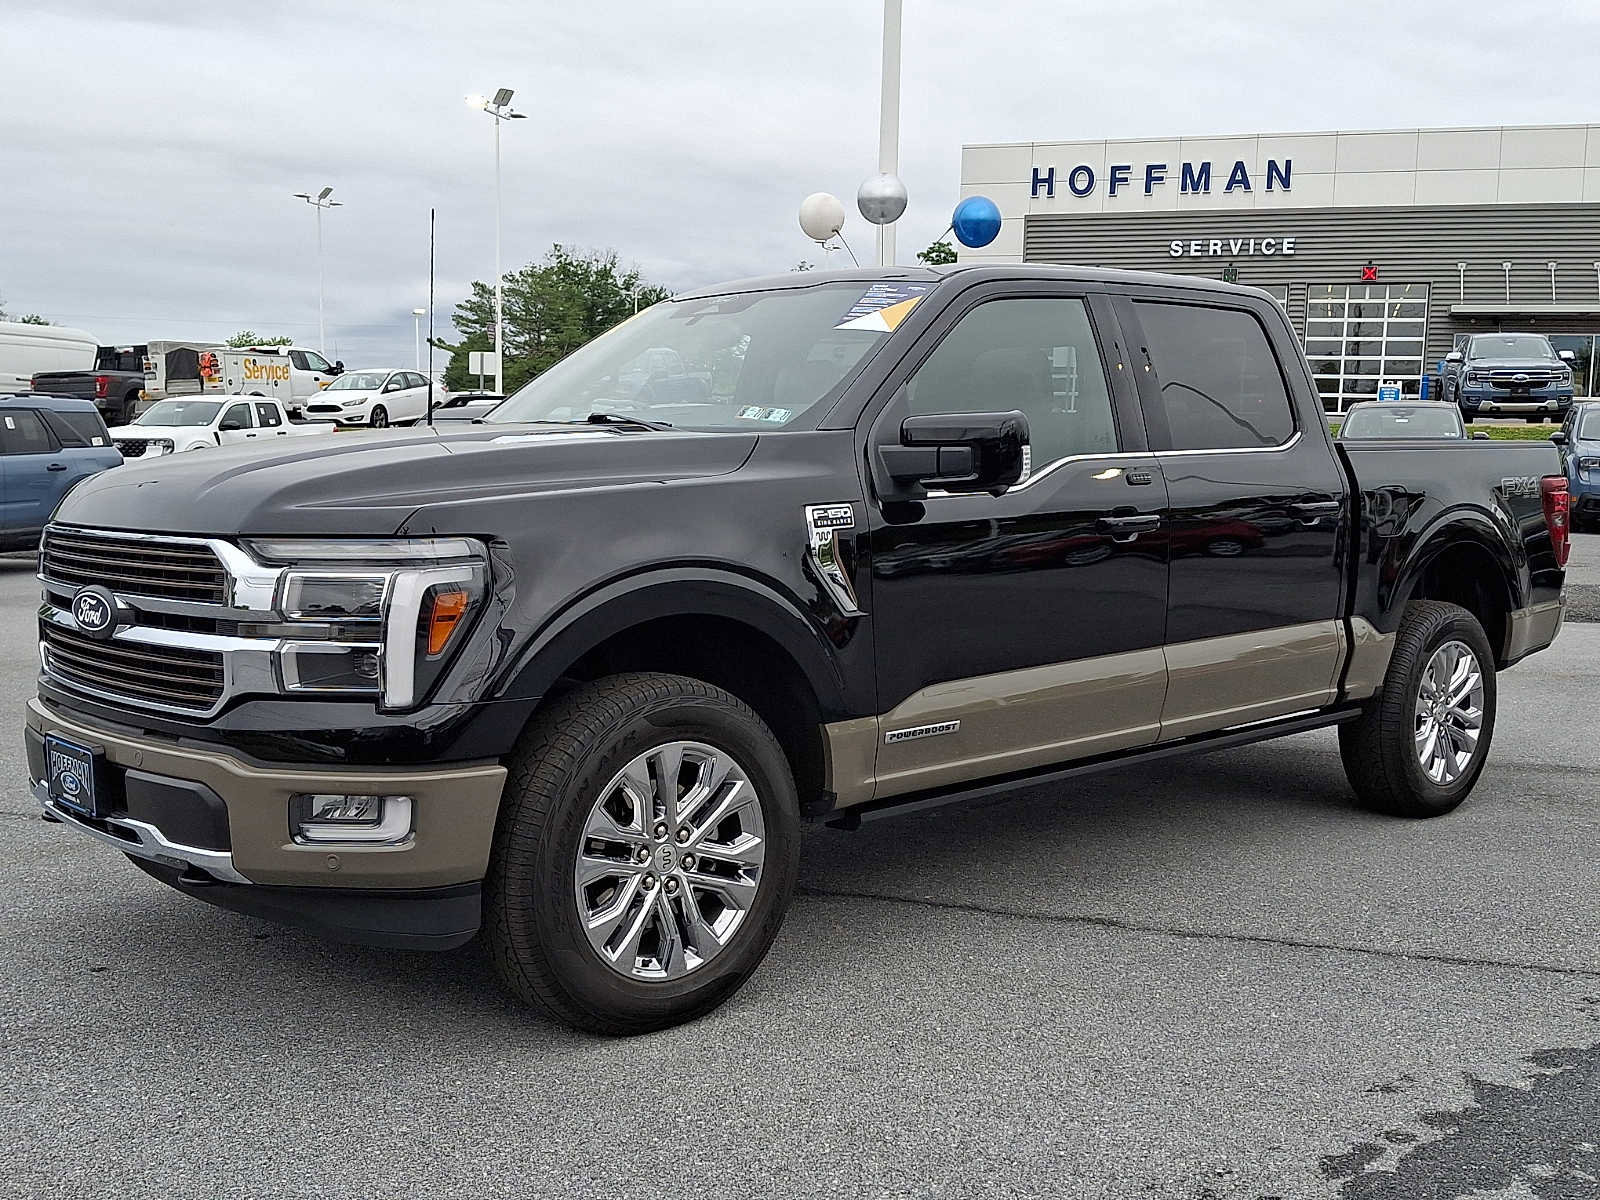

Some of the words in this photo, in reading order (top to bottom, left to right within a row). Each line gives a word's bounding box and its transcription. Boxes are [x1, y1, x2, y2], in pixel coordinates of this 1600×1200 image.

[1031, 159, 1292, 198] HOFFMAN
[1169, 238, 1296, 257] SERVICE
[243, 358, 289, 380] Service
[1501, 477, 1538, 498] FX4
[813, 508, 851, 520] F-150
[78, 597, 103, 625] Ford
[889, 723, 958, 741] POWERBOOST
[50, 750, 90, 796] HOFFMAN
